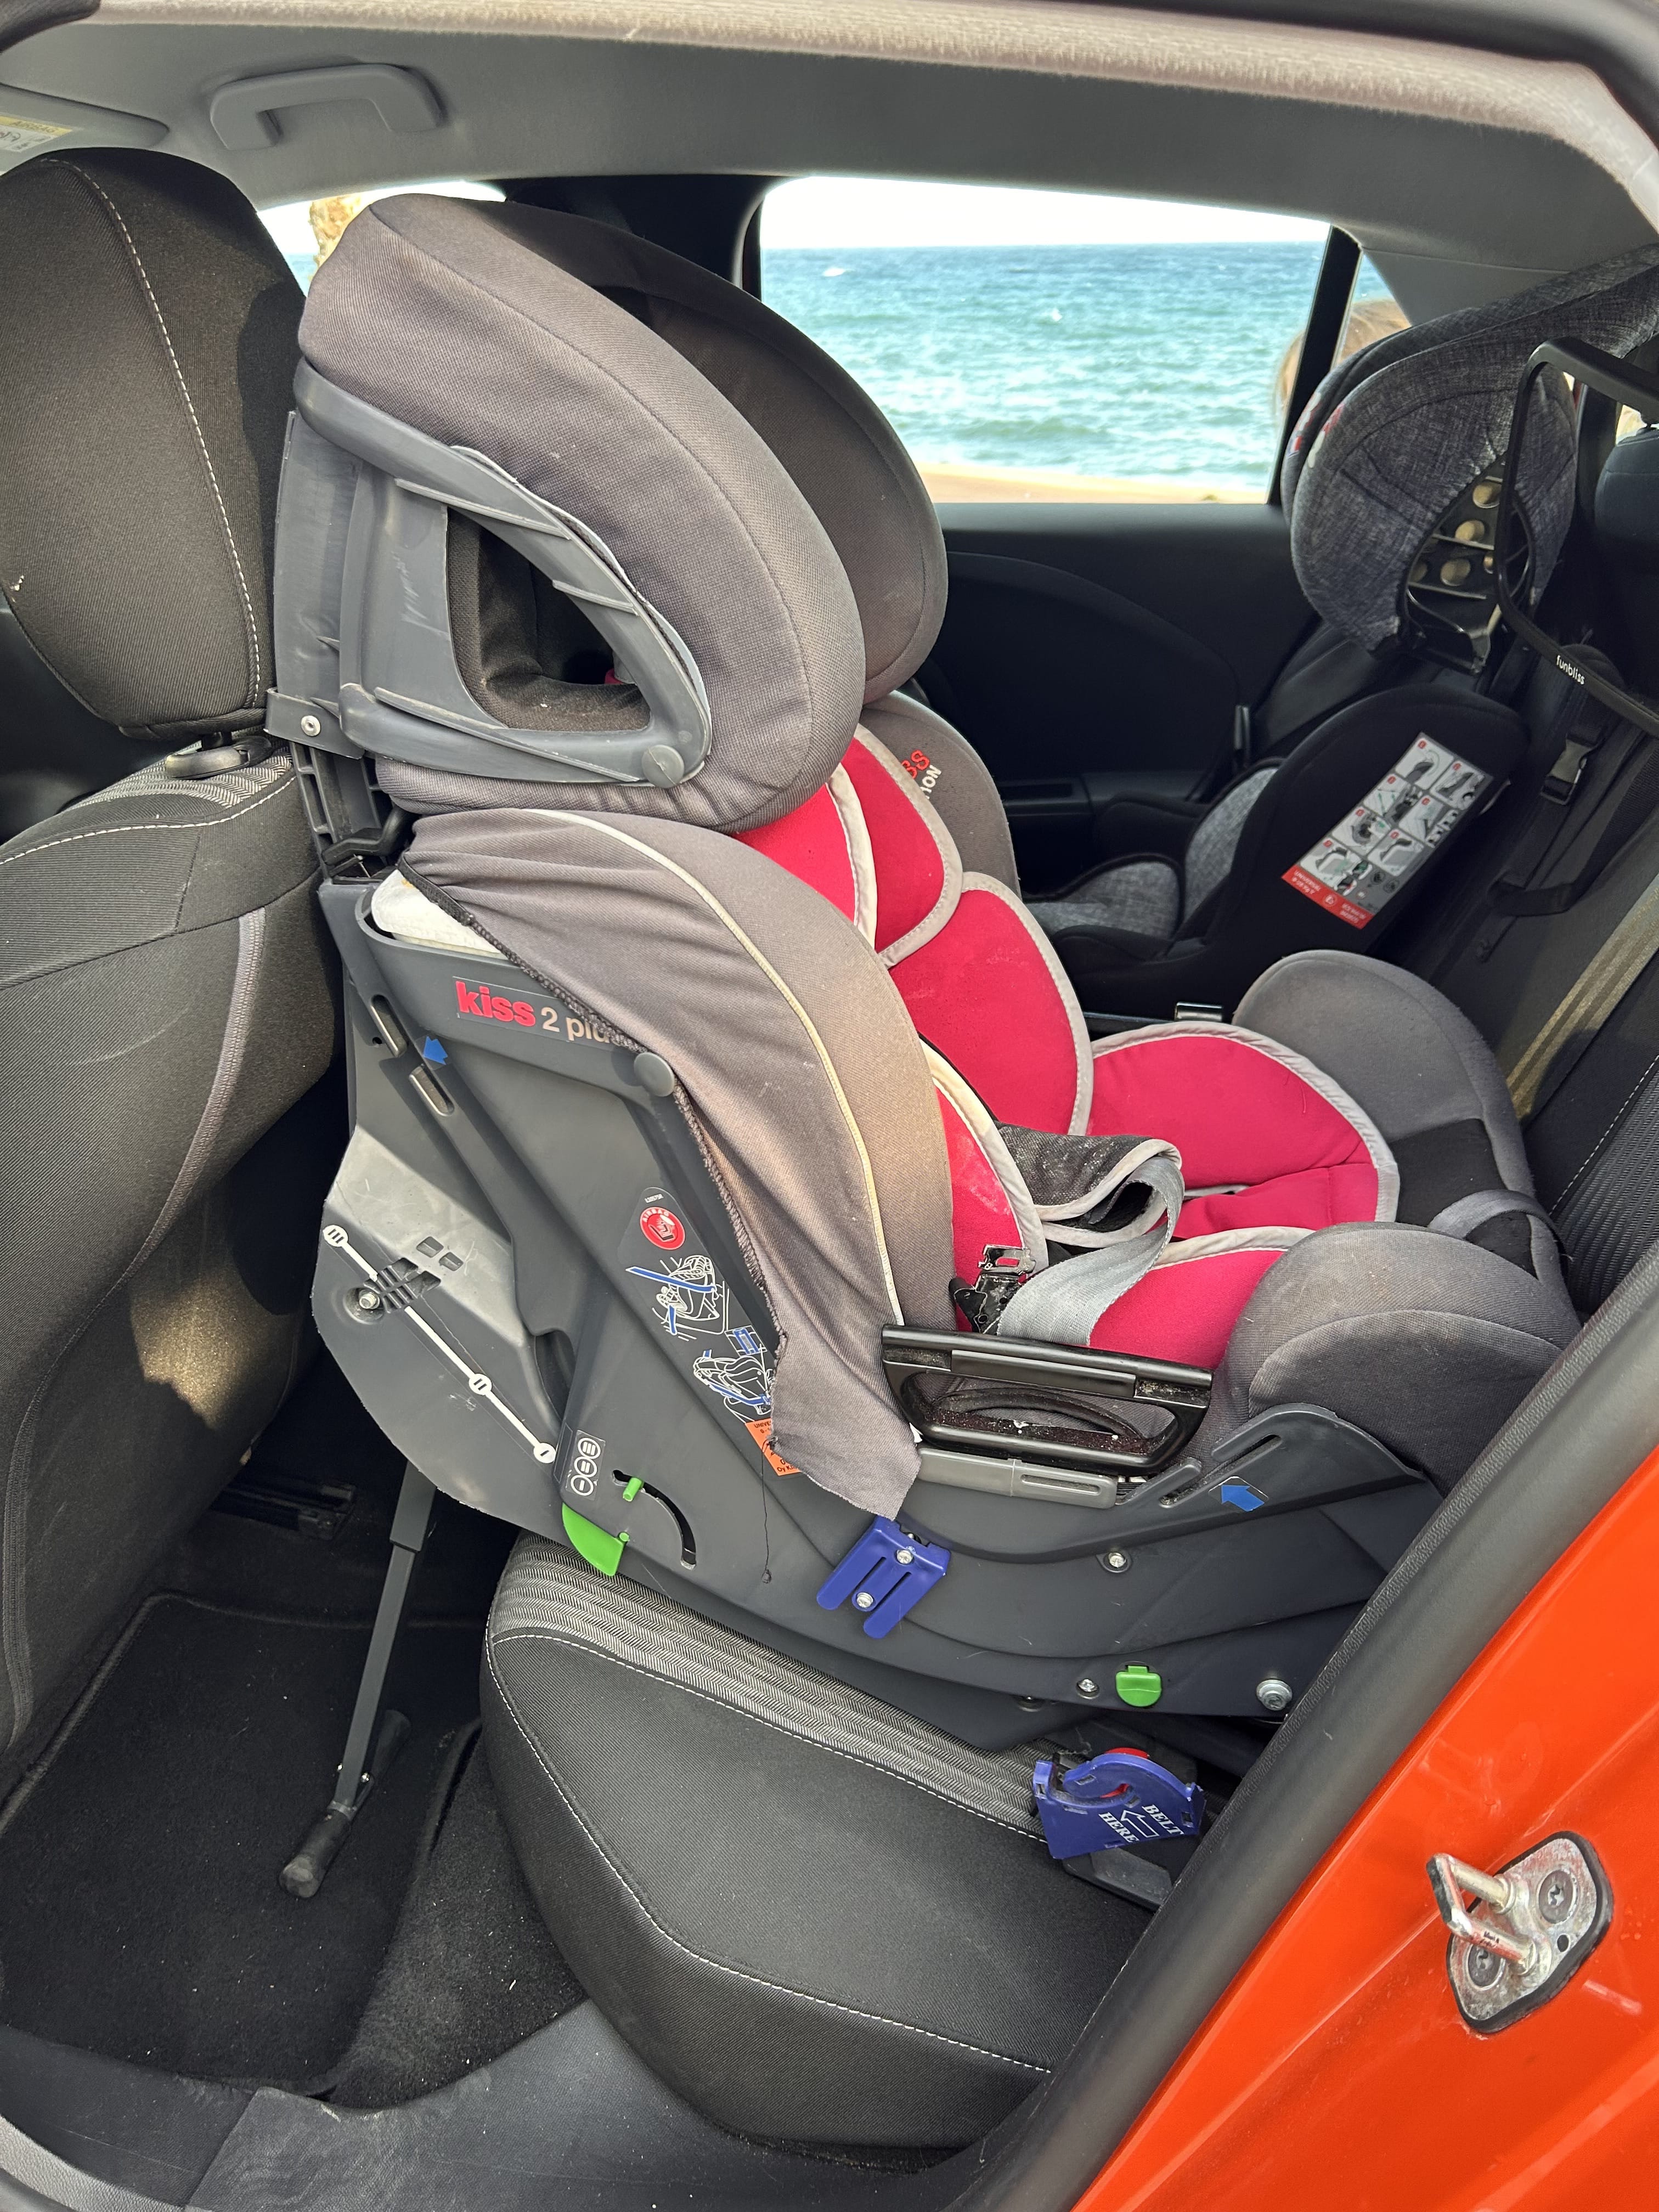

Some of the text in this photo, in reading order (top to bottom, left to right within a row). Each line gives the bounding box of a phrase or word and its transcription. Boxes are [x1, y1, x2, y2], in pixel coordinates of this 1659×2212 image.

[1556, 654, 1585, 685] funbliss
[919, 764, 942, 799] ION
[455, 980, 537, 1027] kiss
[540, 1006, 561, 1033] 2
[1098, 1812, 1139, 1843] HERE
[1142, 1804, 1184, 1835] BELT
